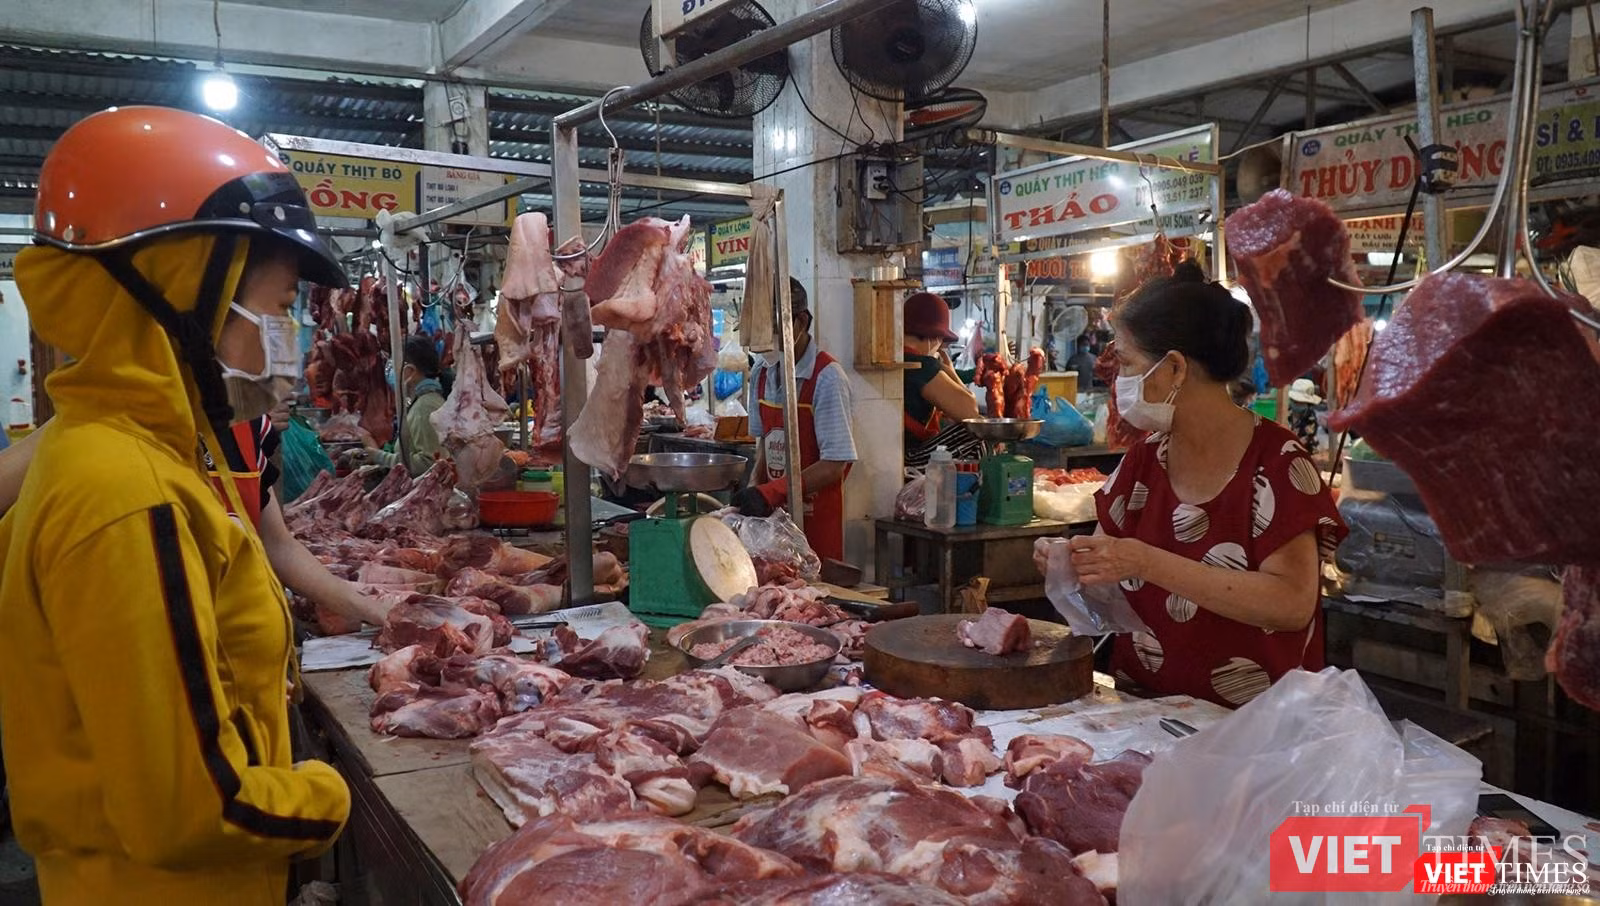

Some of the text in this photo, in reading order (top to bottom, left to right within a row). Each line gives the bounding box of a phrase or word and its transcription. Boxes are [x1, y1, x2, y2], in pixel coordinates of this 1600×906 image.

[1446, 109, 1492, 129] HEO
[1568, 118, 1584, 142] &
[341, 164, 377, 180] THỊT
[382, 165, 402, 180] BÒ
[1053, 169, 1086, 188] THỊT
[1089, 162, 1120, 181] HEO
[1300, 149, 1385, 199] THỦY
[302, 178, 399, 211] ỒNG
[1003, 191, 1120, 231] THẢO
